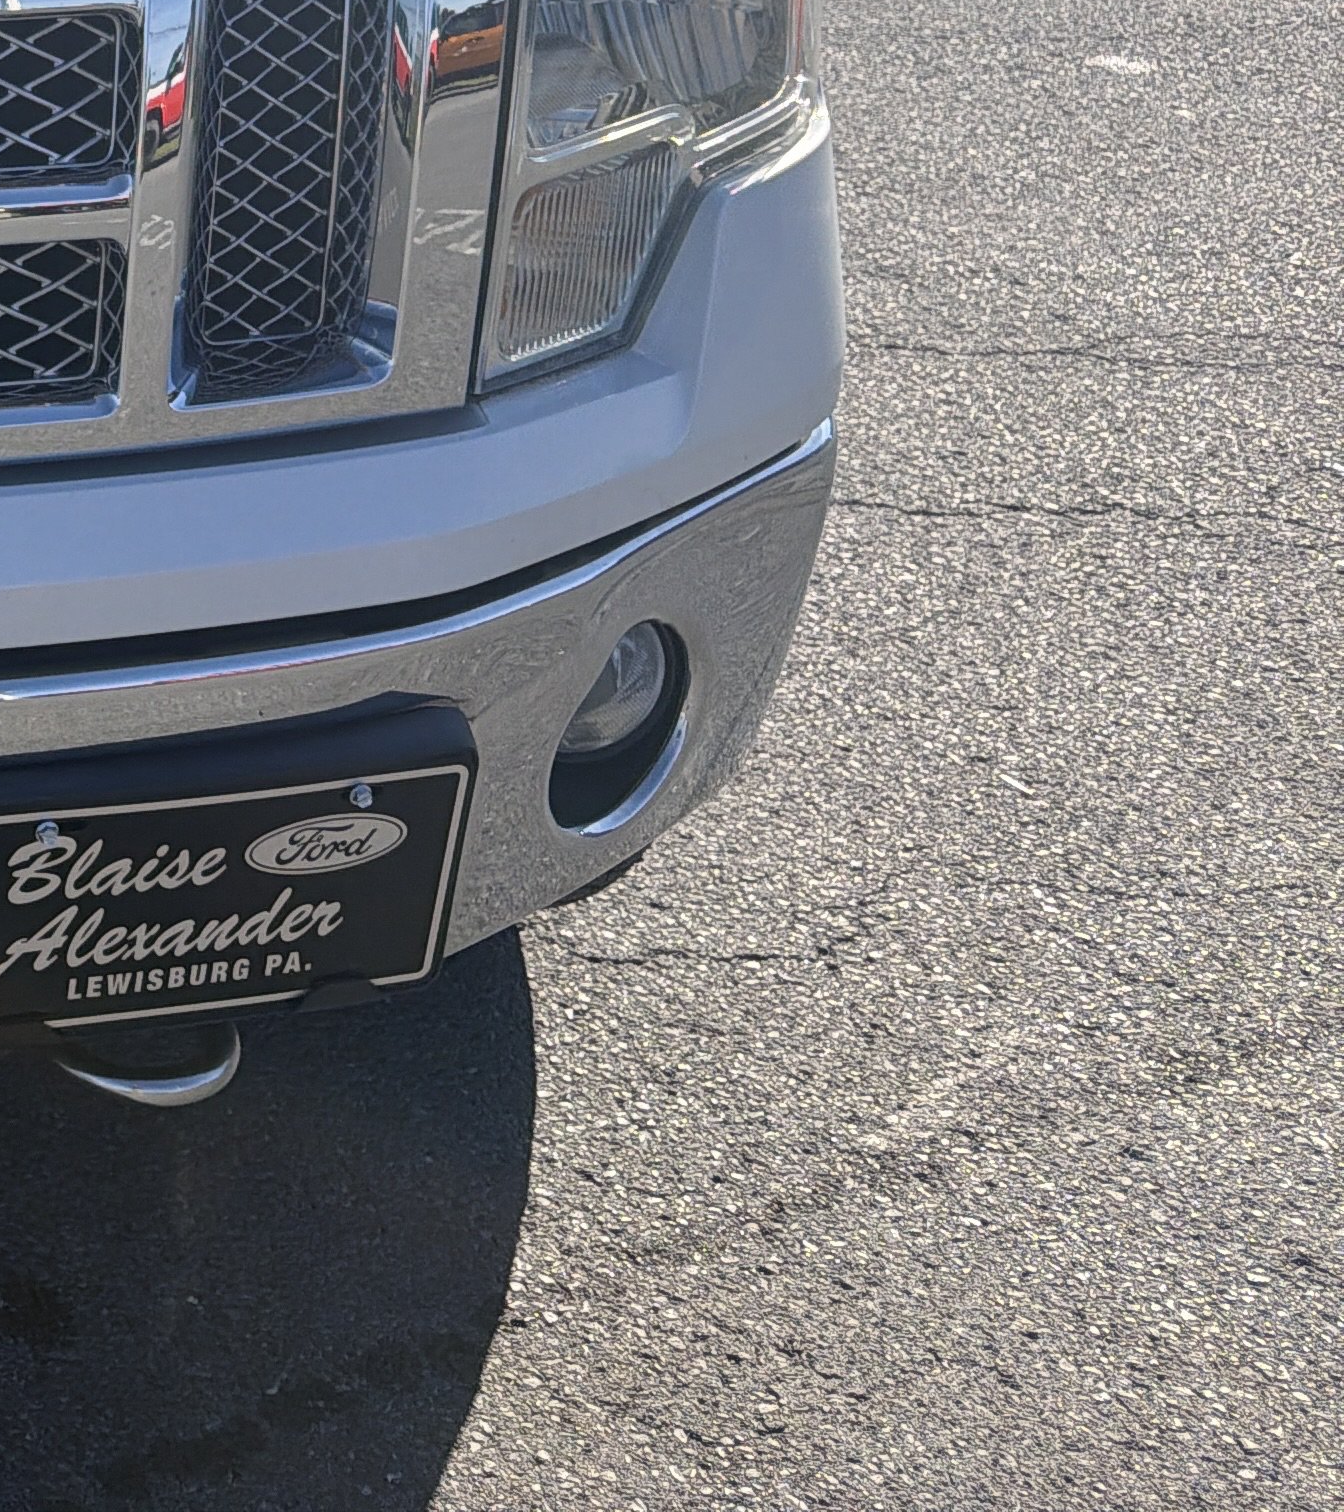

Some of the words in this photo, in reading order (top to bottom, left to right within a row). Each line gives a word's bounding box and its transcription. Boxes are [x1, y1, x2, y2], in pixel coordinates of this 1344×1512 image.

[7, 835, 228, 905] Blaise
[274, 823, 378, 866] Ford
[66, 957, 251, 1001] LEWISBURG
[264, 951, 313, 977] PA.
